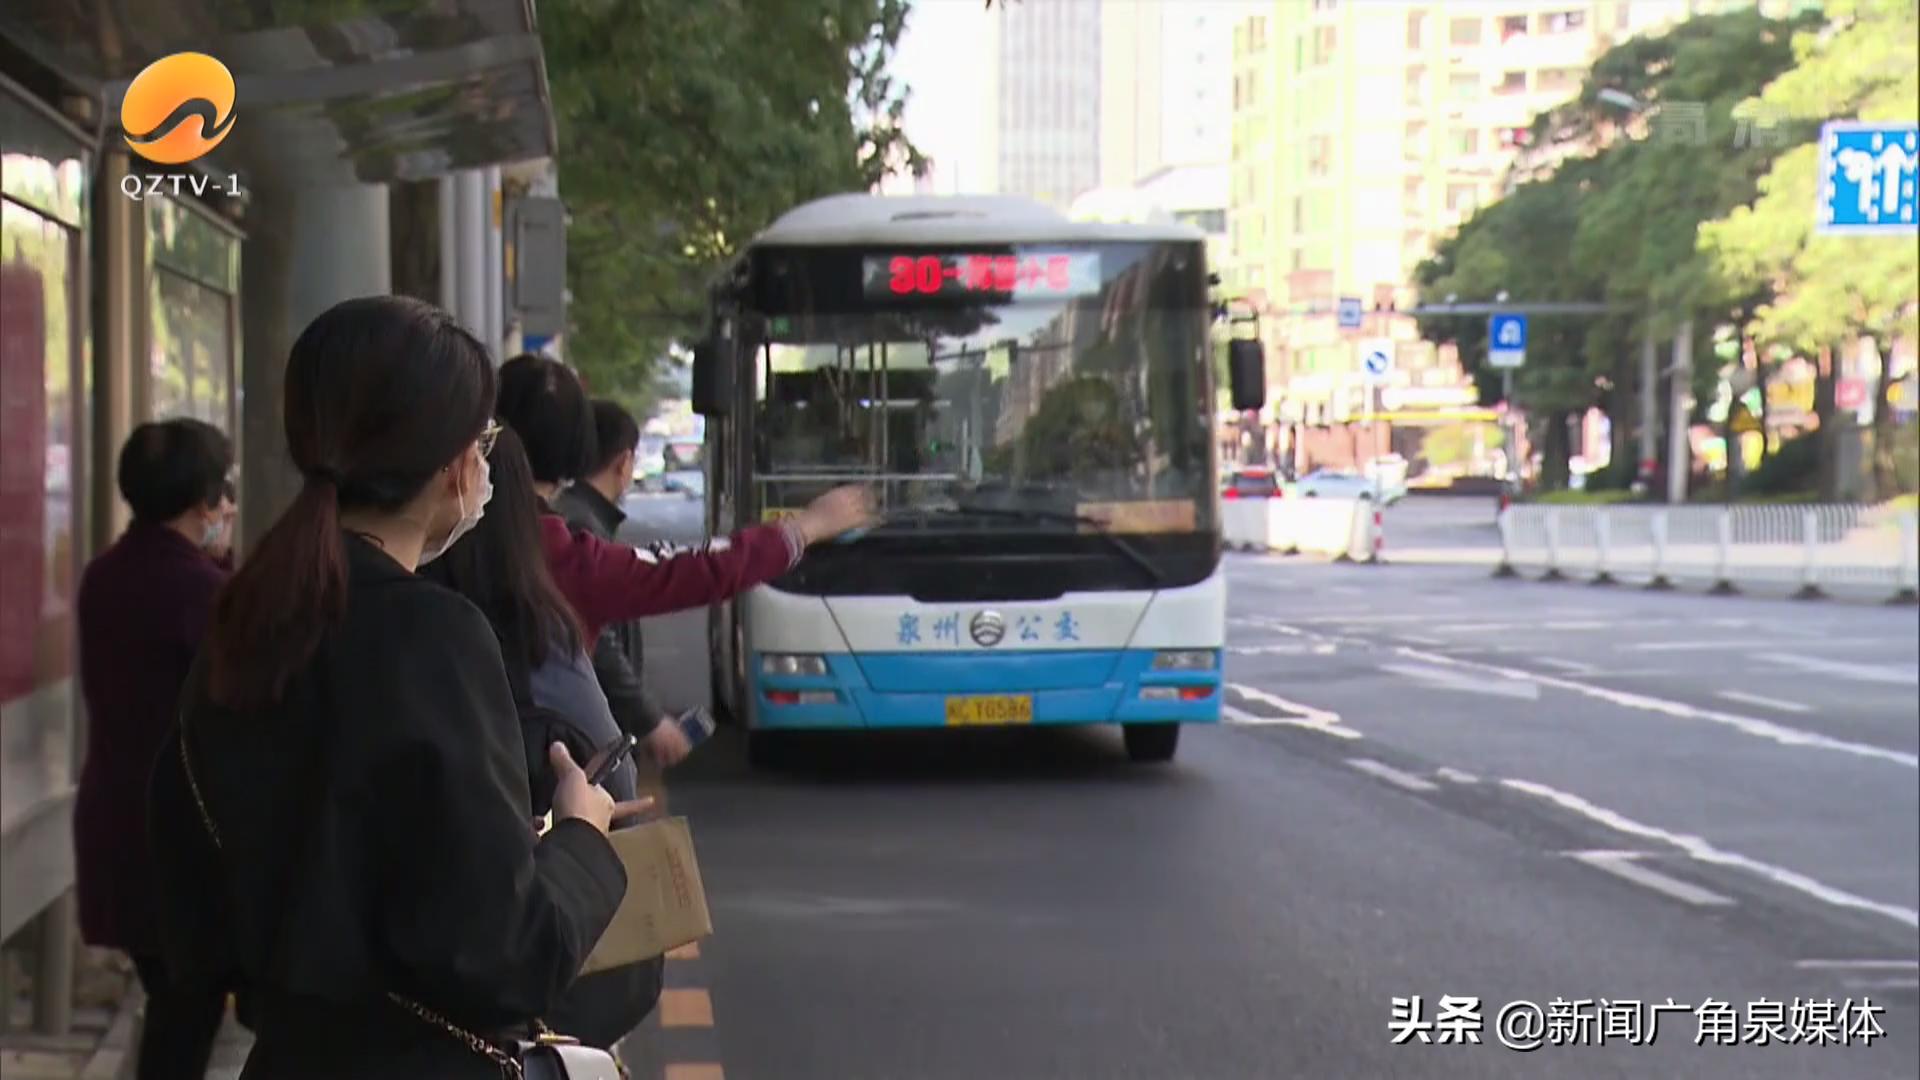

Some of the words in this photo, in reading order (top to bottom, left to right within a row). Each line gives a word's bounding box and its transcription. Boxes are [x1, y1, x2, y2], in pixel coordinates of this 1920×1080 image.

[889, 256, 942, 293] 30
[898, 612, 960, 646] 泉州
[1016, 611, 1080, 642] 公交
